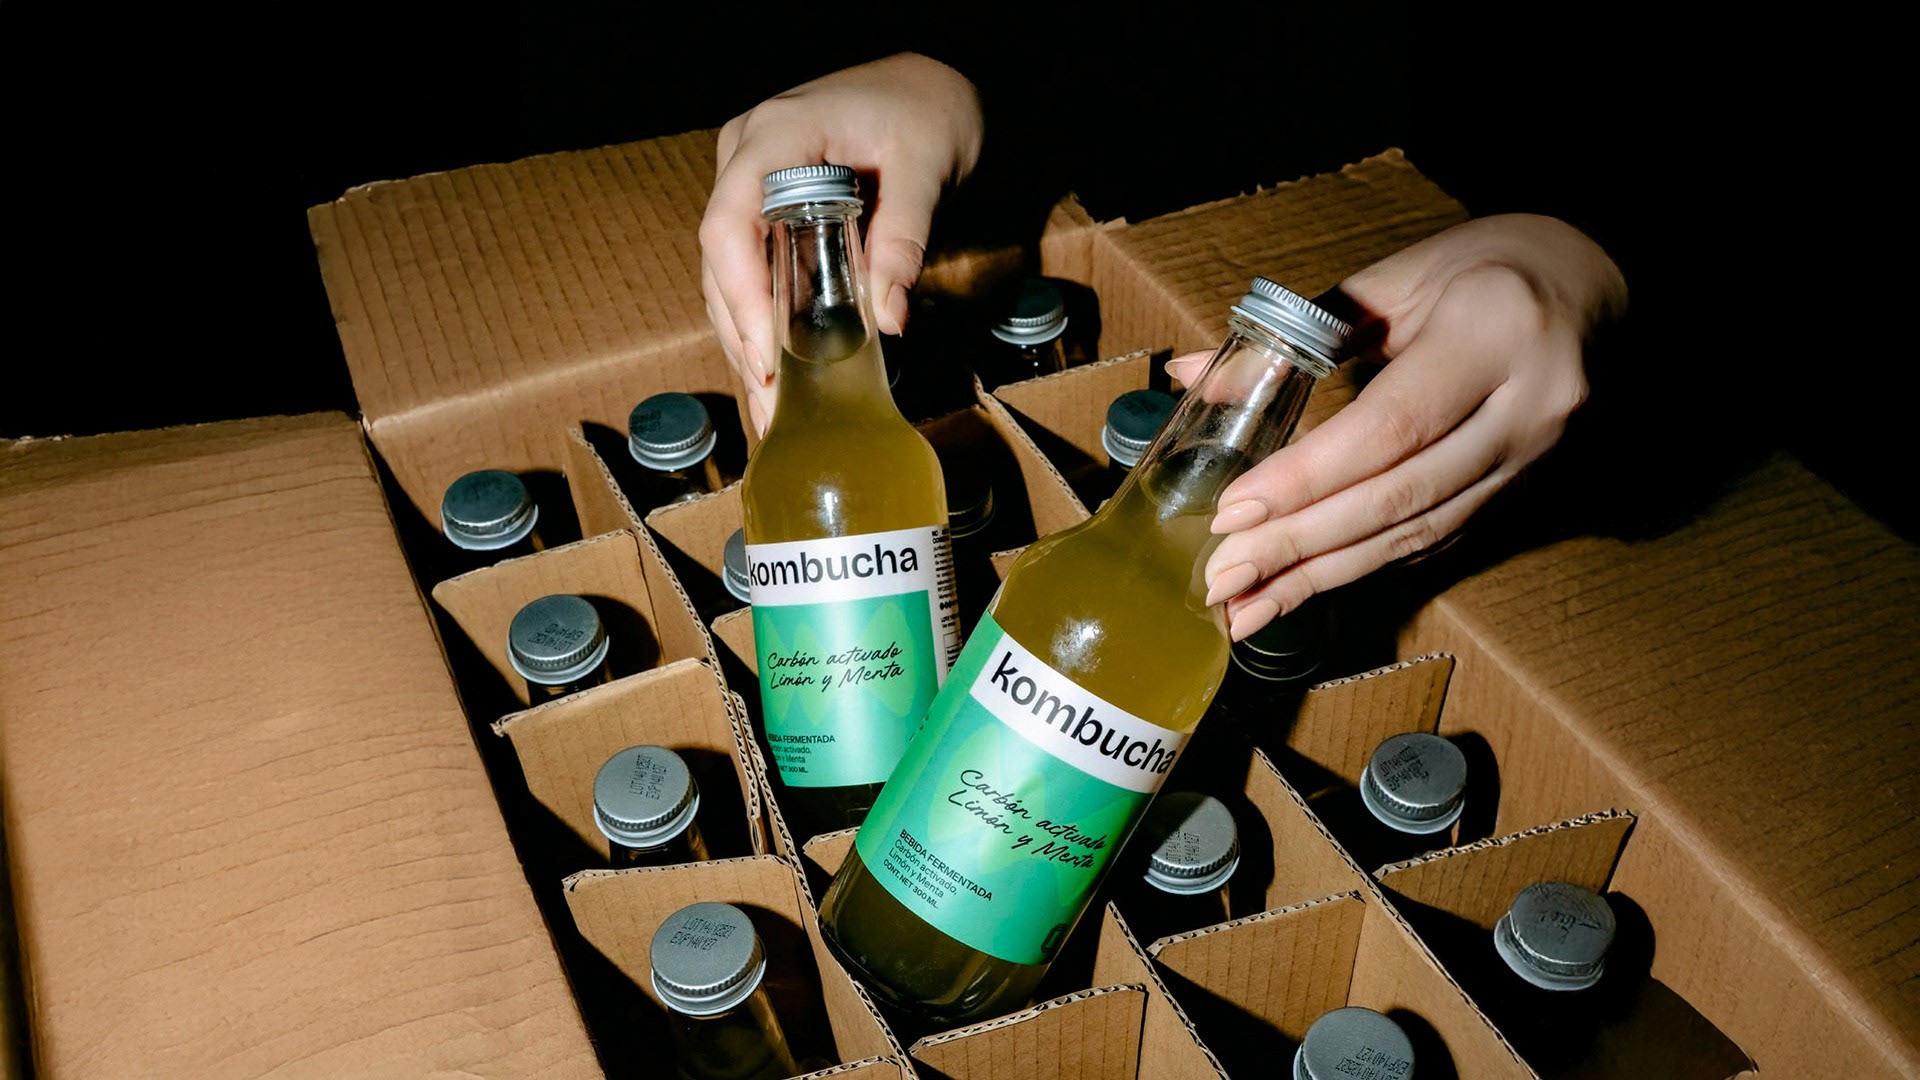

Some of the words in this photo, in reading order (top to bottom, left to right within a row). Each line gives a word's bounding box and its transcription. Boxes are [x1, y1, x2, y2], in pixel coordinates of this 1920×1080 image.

[748, 544, 918, 586] kombucha
[767, 651, 819, 670] Carbón
[826, 641, 903, 666] activado
[770, 672, 816, 690] Limón
[821, 676, 833, 693] y
[838, 662, 905, 688] Menta
[990, 651, 1177, 774] kombucha
[783, 735, 836, 744] FERMENTADA
[948, 789, 1013, 834] Limón
[1011, 835, 1034, 850] y
[1030, 841, 1095, 868] Menta
[960, 769, 1032, 819] Carbón
[1035, 820, 1107, 850] activado
[888, 847, 911, 873] Limón
[910, 869, 917, 878] y
[916, 873, 944, 898] Menta
[894, 839, 920, 867] Carbón
[920, 864, 957, 896] activado,
[899, 829, 927, 859] BEBIDA
[927, 853, 992, 901] FERMENTADA
[899, 874, 914, 889] NET
[912, 885, 927, 900] 300
[926, 896, 939, 909] ML.
